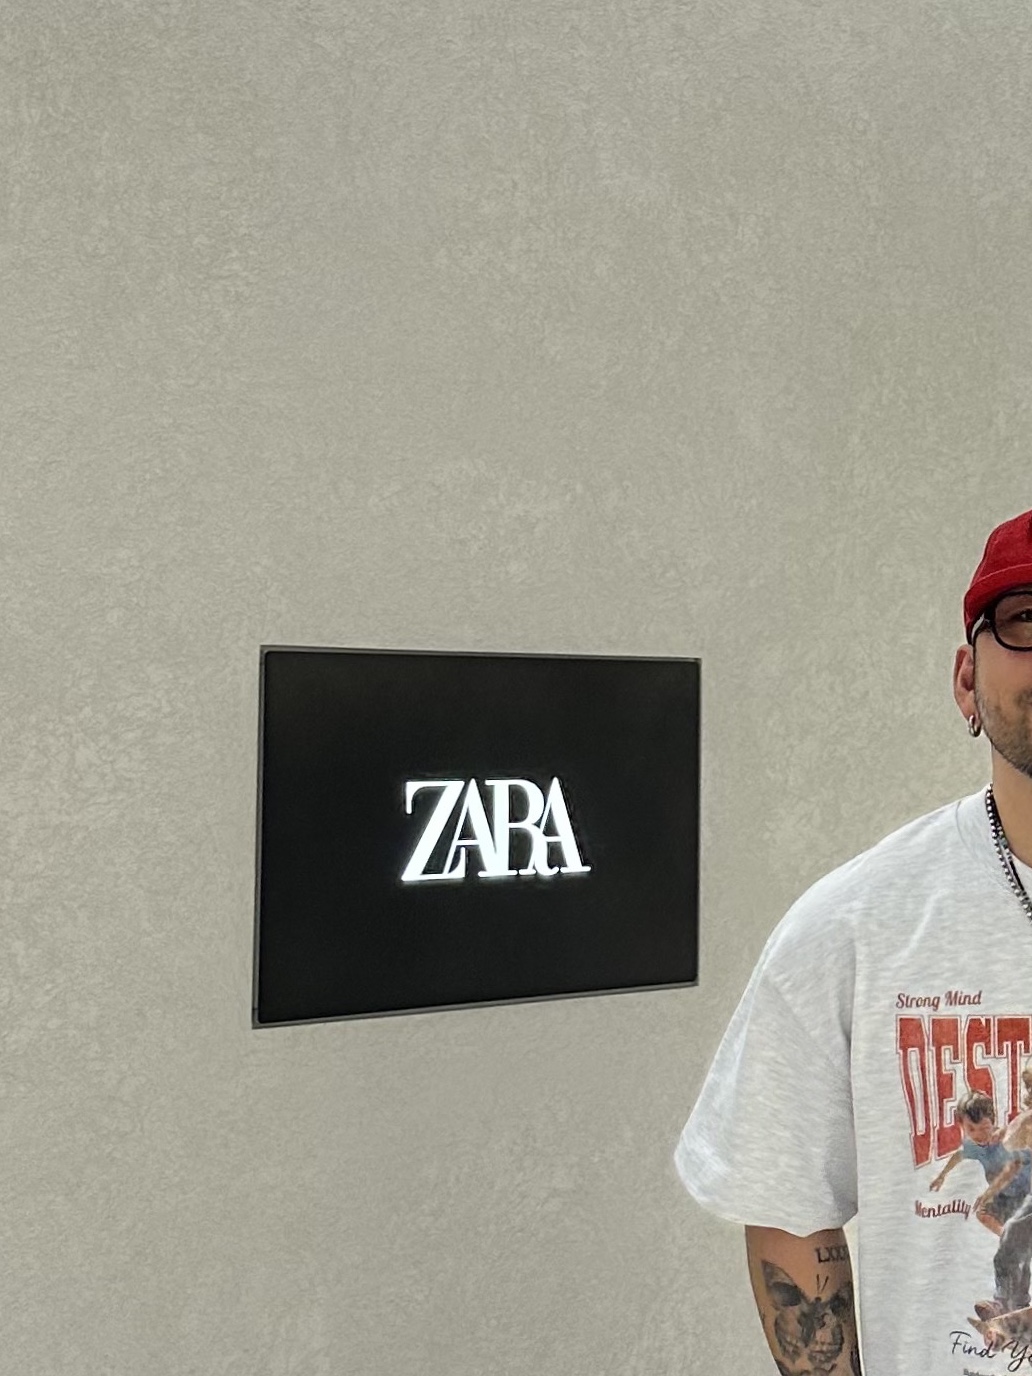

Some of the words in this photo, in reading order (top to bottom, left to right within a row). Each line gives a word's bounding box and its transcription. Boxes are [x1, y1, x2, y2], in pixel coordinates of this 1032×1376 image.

[401, 776, 592, 881] ZARA
[895, 993, 940, 1012] Strong
[945, 990, 983, 1006] Mind
[915, 1199, 971, 1220] Mentality
[949, 1330, 996, 1358] Find
